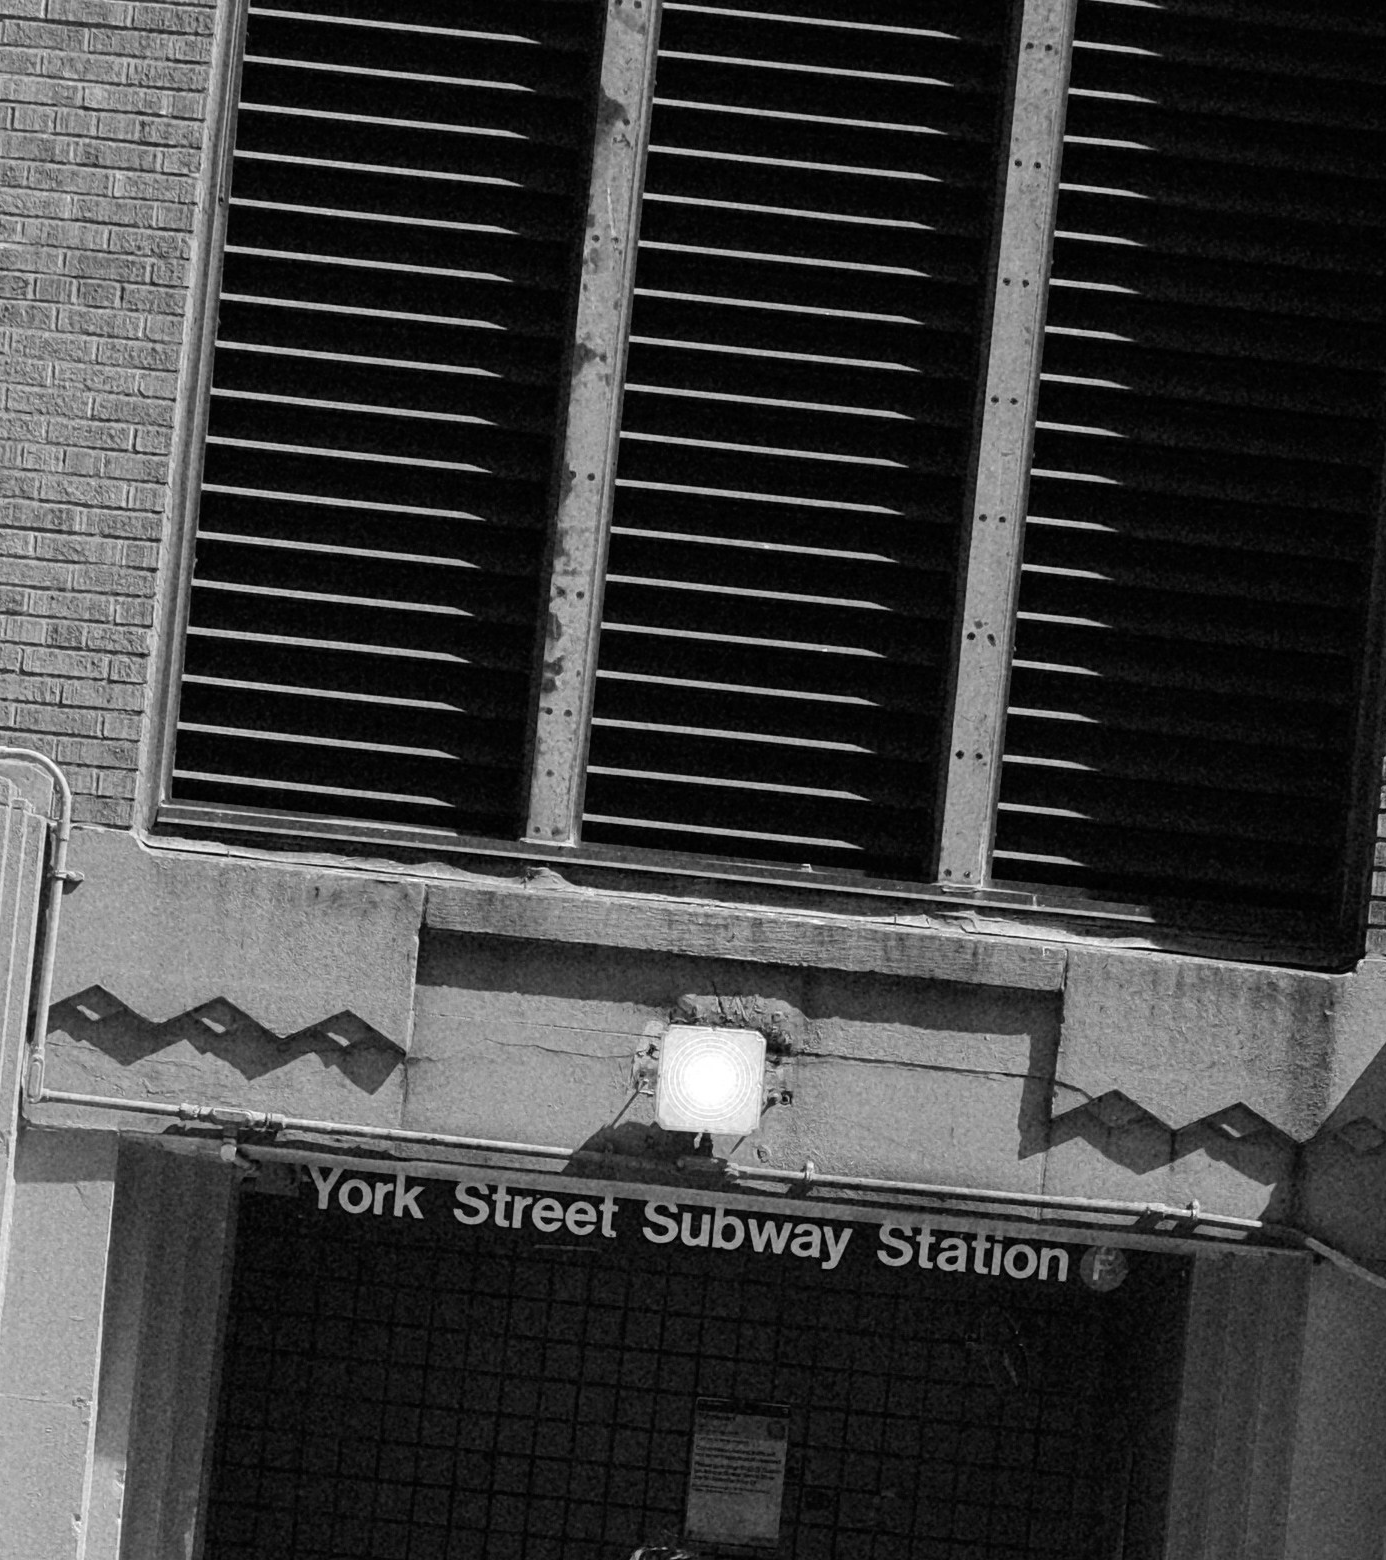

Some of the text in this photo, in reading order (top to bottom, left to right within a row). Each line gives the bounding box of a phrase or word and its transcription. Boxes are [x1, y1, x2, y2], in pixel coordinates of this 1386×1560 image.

[309, 1164, 425, 1220] York
[452, 1180, 618, 1240] Street
[642, 1200, 854, 1270] Subway
[876, 1222, 1070, 1283] Station
